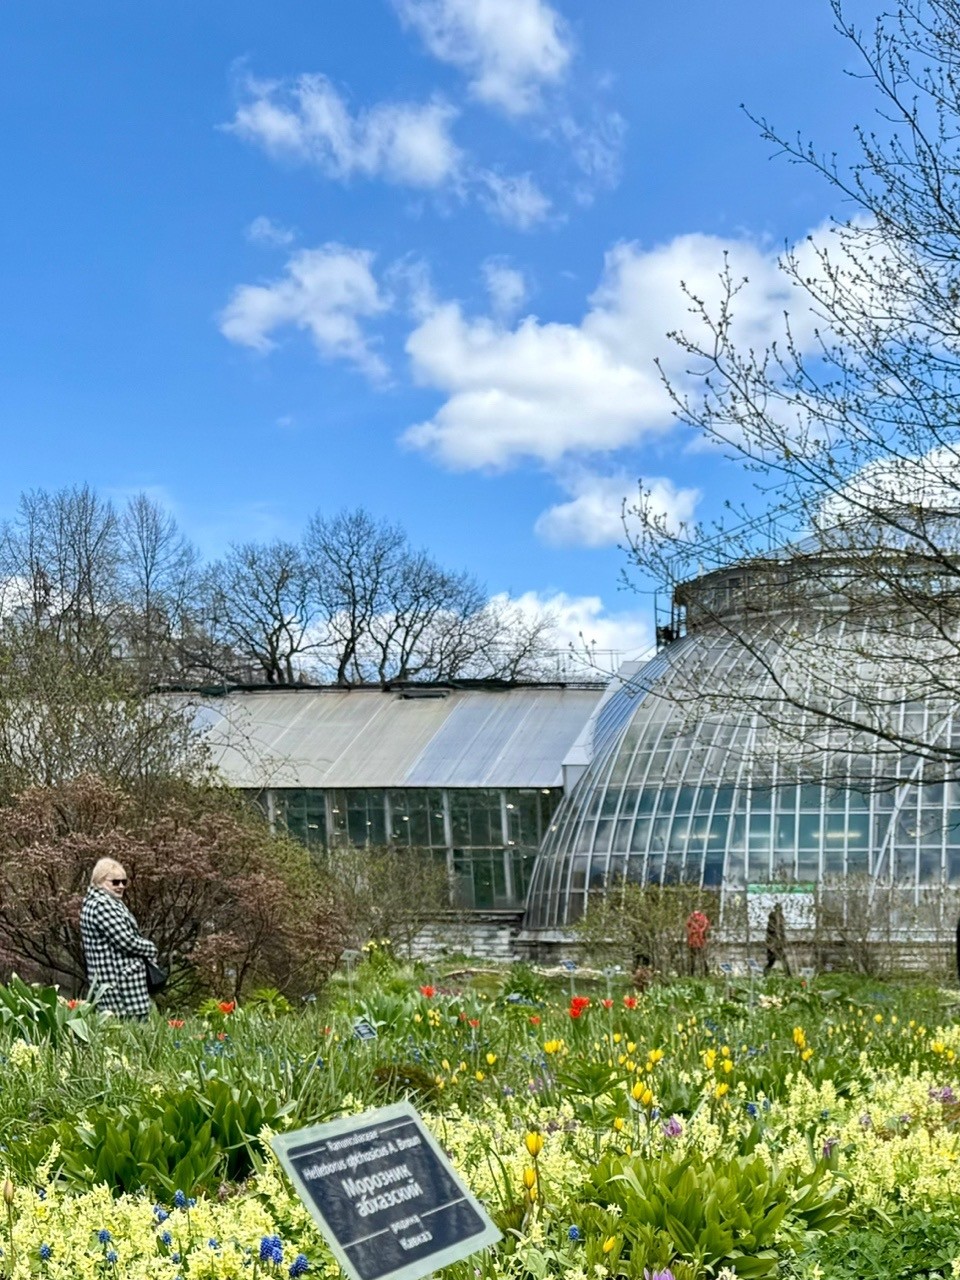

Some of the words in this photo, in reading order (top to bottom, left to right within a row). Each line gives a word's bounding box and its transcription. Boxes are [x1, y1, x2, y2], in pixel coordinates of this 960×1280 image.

[303, 1160, 347, 1180] Helleborus
[341, 1163, 414, 1199] Морозник
[355, 1177, 423, 1217] абхазский
[389, 1214, 420, 1234] родина
[399, 1230, 432, 1250] Кавказ
